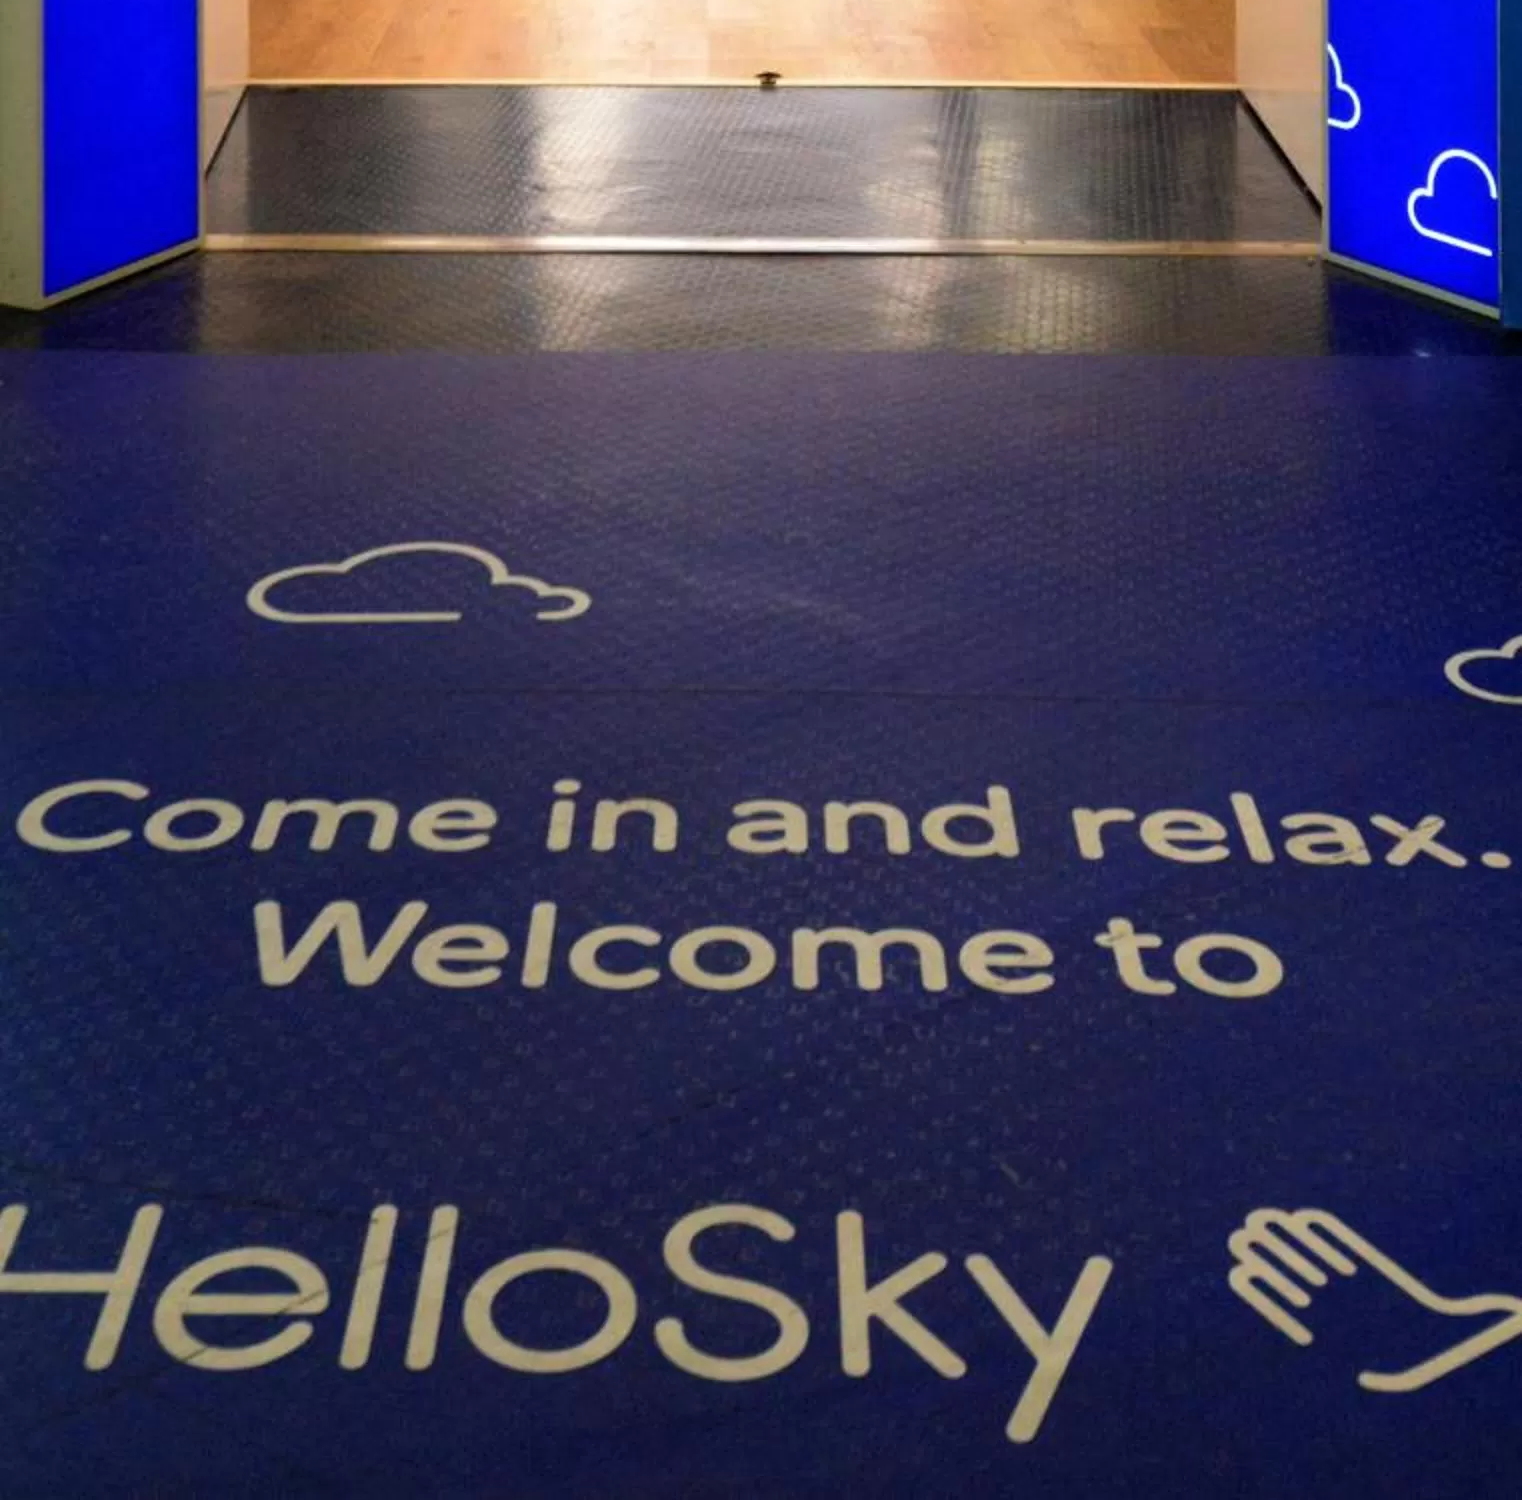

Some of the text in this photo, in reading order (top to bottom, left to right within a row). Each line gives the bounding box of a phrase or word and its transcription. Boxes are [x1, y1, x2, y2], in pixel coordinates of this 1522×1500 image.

[15, 778, 1513, 869] Come in and relax.
[253, 900, 1285, 998] Welcome to
[0, 1203, 1114, 1445] HelloSky
